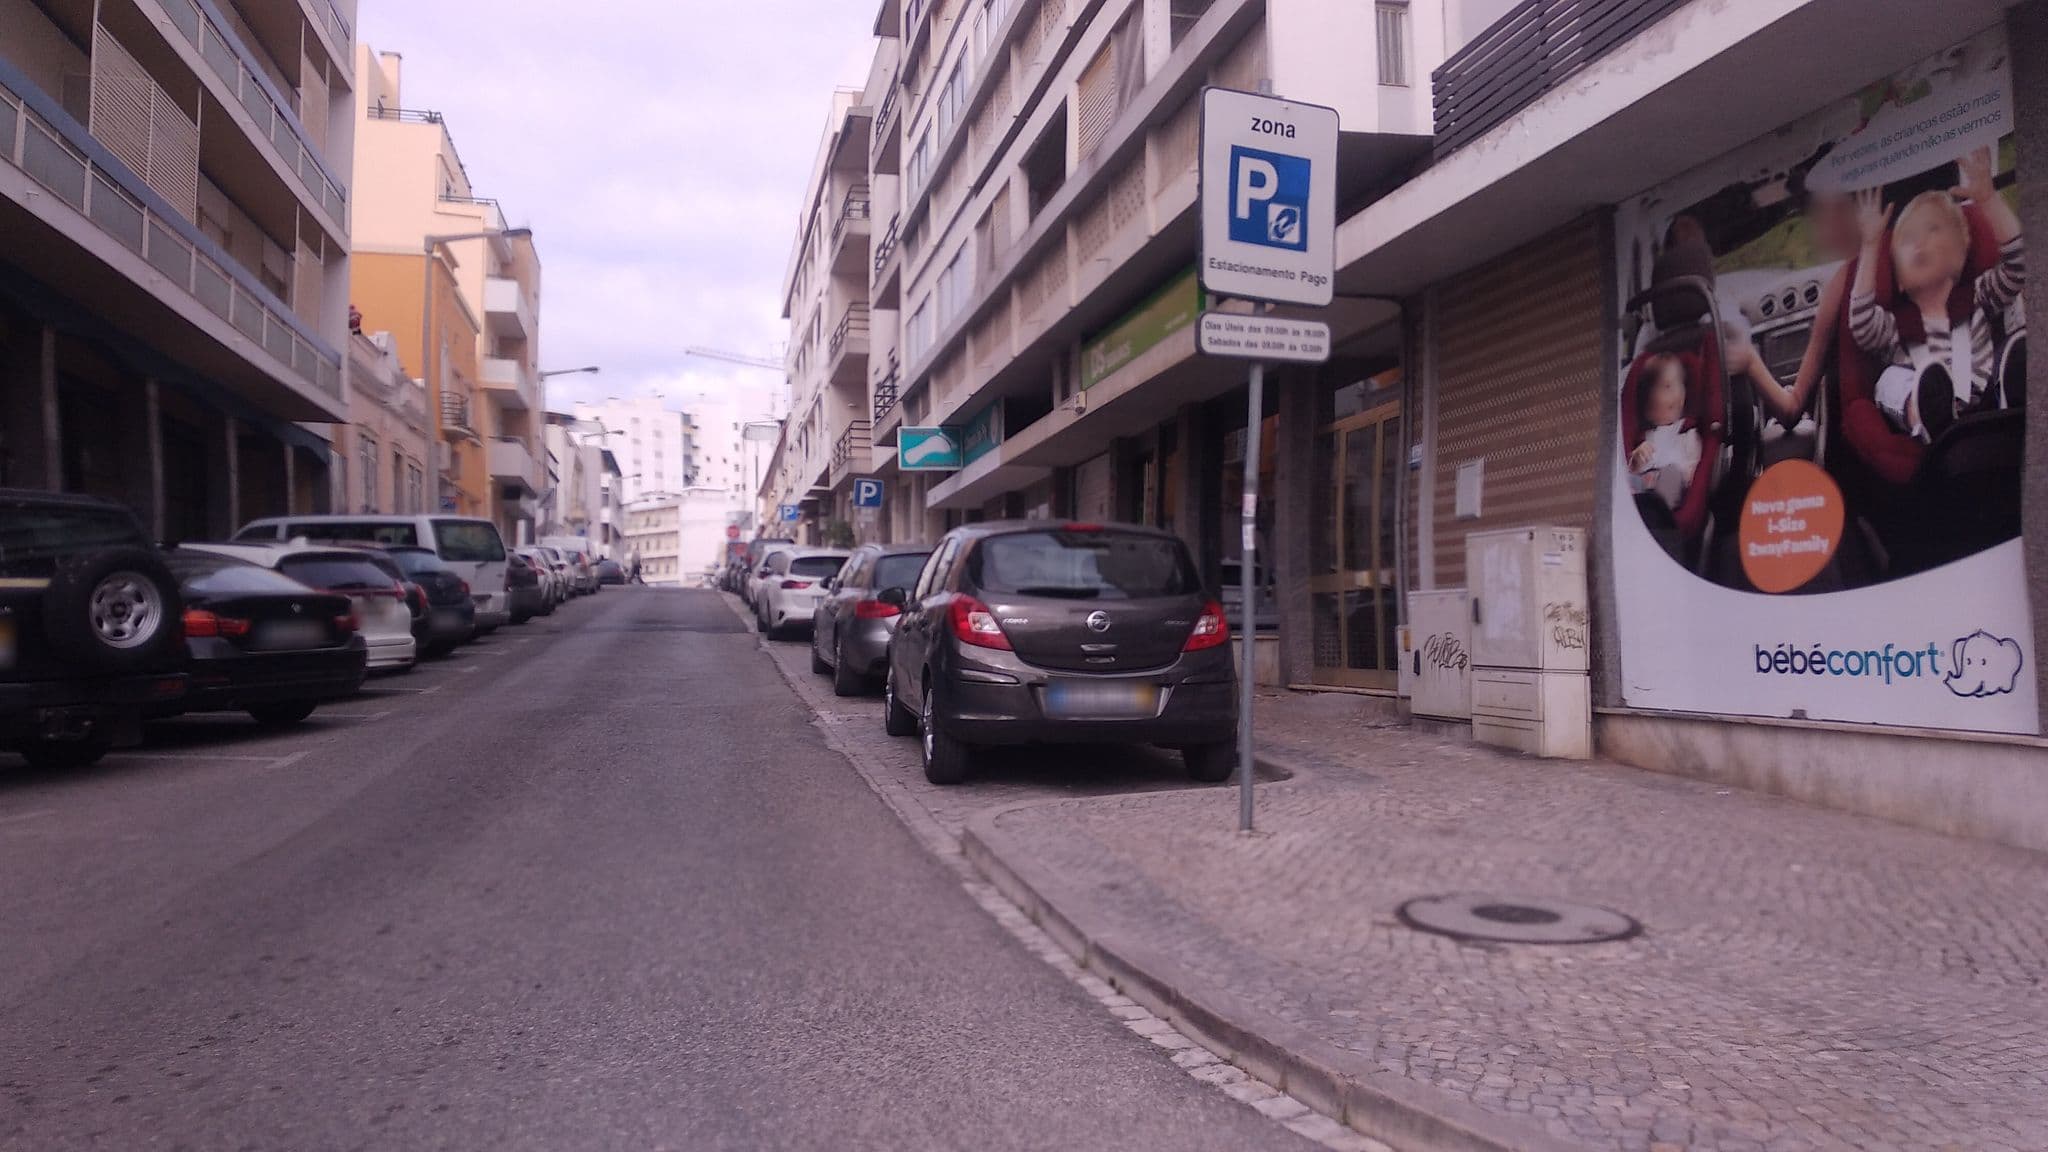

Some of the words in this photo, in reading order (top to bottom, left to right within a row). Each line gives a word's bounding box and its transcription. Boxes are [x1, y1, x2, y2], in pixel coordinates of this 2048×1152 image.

[1251, 117, 1296, 138] zona
[1893, 117, 1938, 142] crianças
[1939, 103, 1969, 125] estão
[1971, 89, 2001, 110] mais
[1920, 132, 1942, 151] não
[1942, 128, 1957, 143] as
[1957, 110, 2002, 137] vermos
[1236, 155, 1279, 220] P
[1208, 257, 1296, 280] Estacionamento
[1300, 270, 1328, 287] Pago
[1205, 321, 1222, 331] Dias
[1248, 325, 1261, 334] das
[1244, 340, 1258, 349] das
[859, 482, 878, 506] P
[1751, 501, 1785, 515] Nova
[1786, 495, 1824, 514] gama
[1755, 641, 1941, 685] bébéconfort
